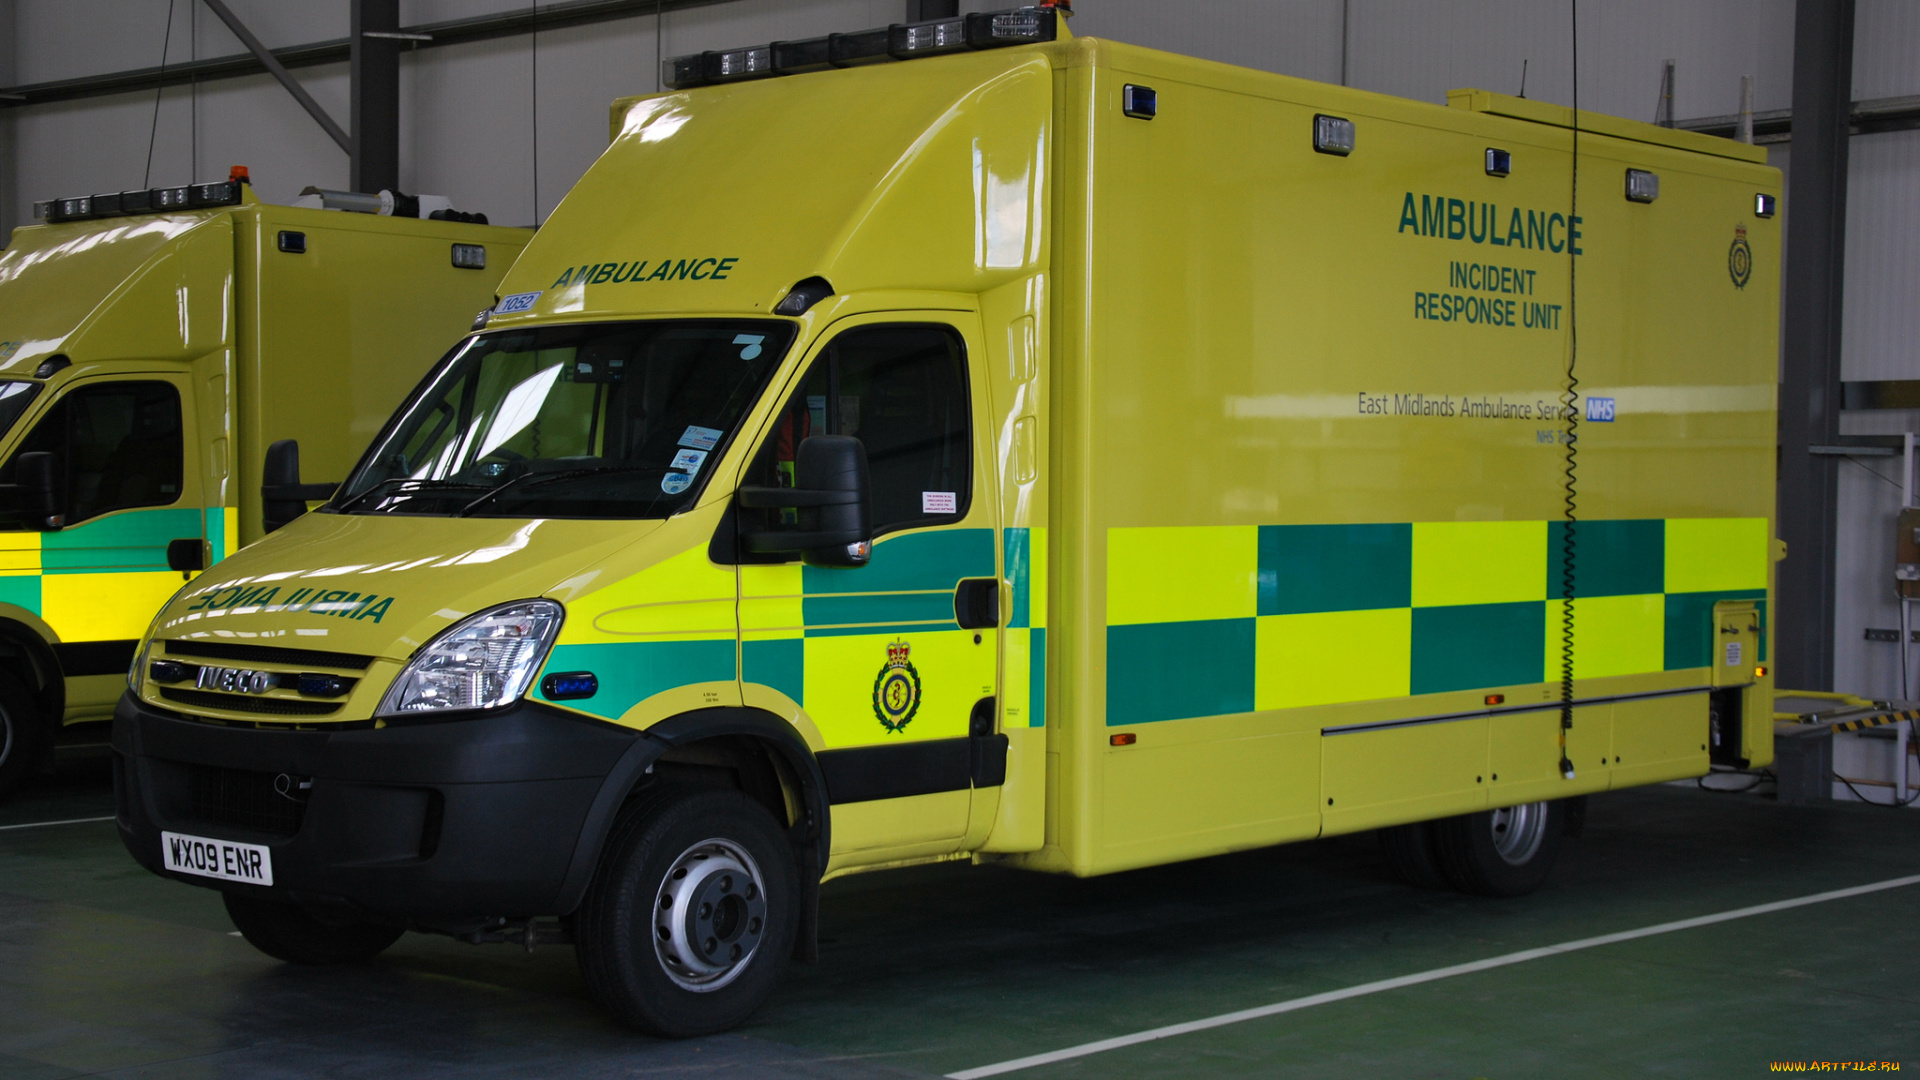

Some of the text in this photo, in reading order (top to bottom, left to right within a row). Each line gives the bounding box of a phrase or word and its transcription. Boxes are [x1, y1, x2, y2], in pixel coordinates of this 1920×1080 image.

[1398, 192, 1583, 256] AMBULANCE
[550, 257, 739, 289] AMBULANCE
[1450, 261, 1537, 295] INCIDENT
[503, 295, 534, 311] 1052
[1414, 292, 1562, 330] RESPONSE UNIT
[1358, 392, 1388, 415] East
[1394, 393, 1455, 417] Midlands
[1460, 397, 1532, 420] Ambulance
[1586, 398, 1614, 421] NHS
[1536, 430, 1555, 444] NHS
[195, 666, 268, 694] IVECO
[170, 837, 263, 880] WX09 ENR
